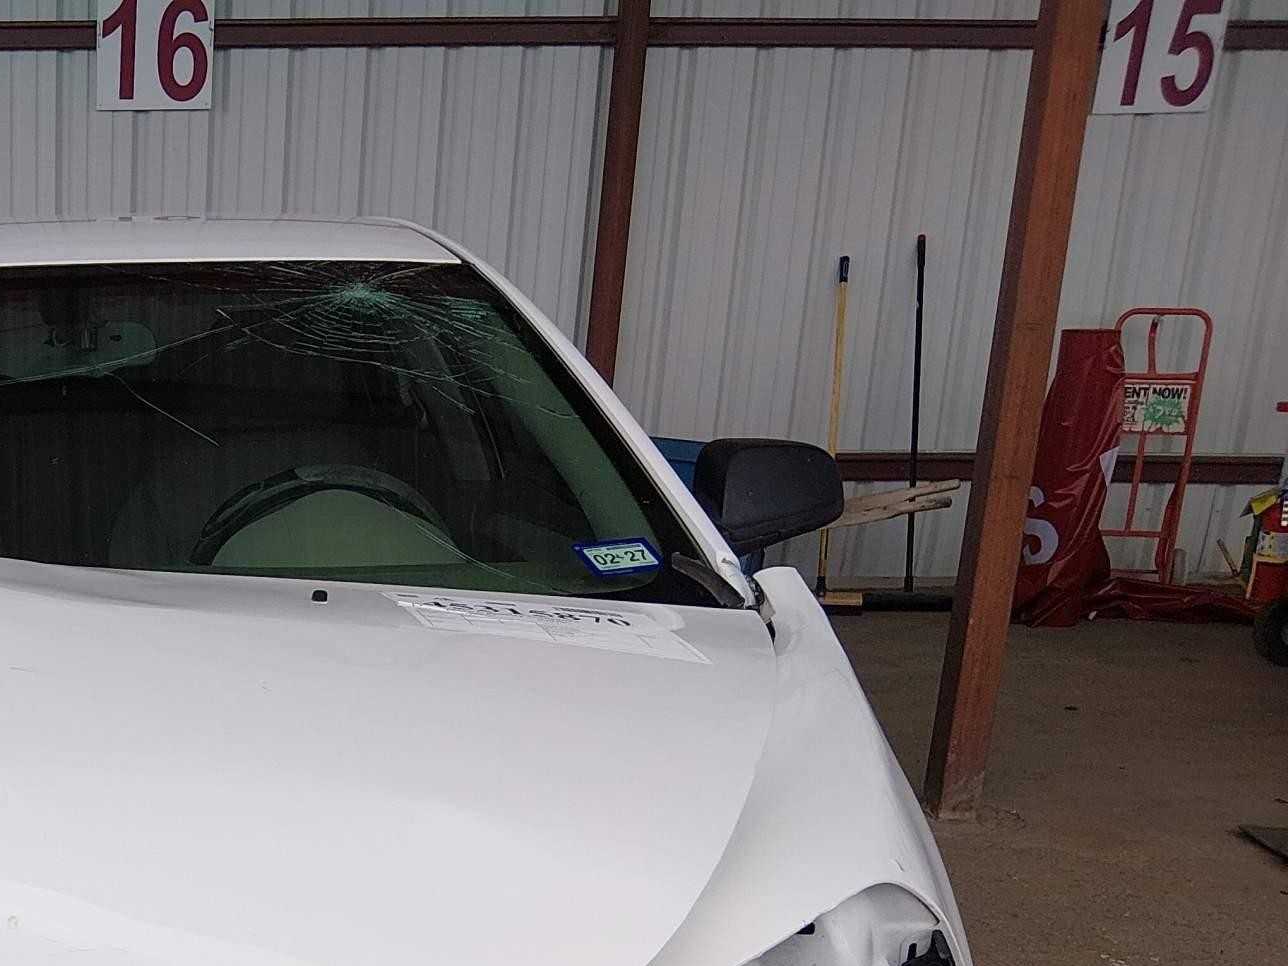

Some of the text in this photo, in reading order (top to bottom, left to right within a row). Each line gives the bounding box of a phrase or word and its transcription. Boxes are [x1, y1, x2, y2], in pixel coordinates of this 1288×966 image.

[102, 0, 209, 102] 16
[1113, 0, 1223, 107] 15
[1152, 386, 1189, 400] NOW!
